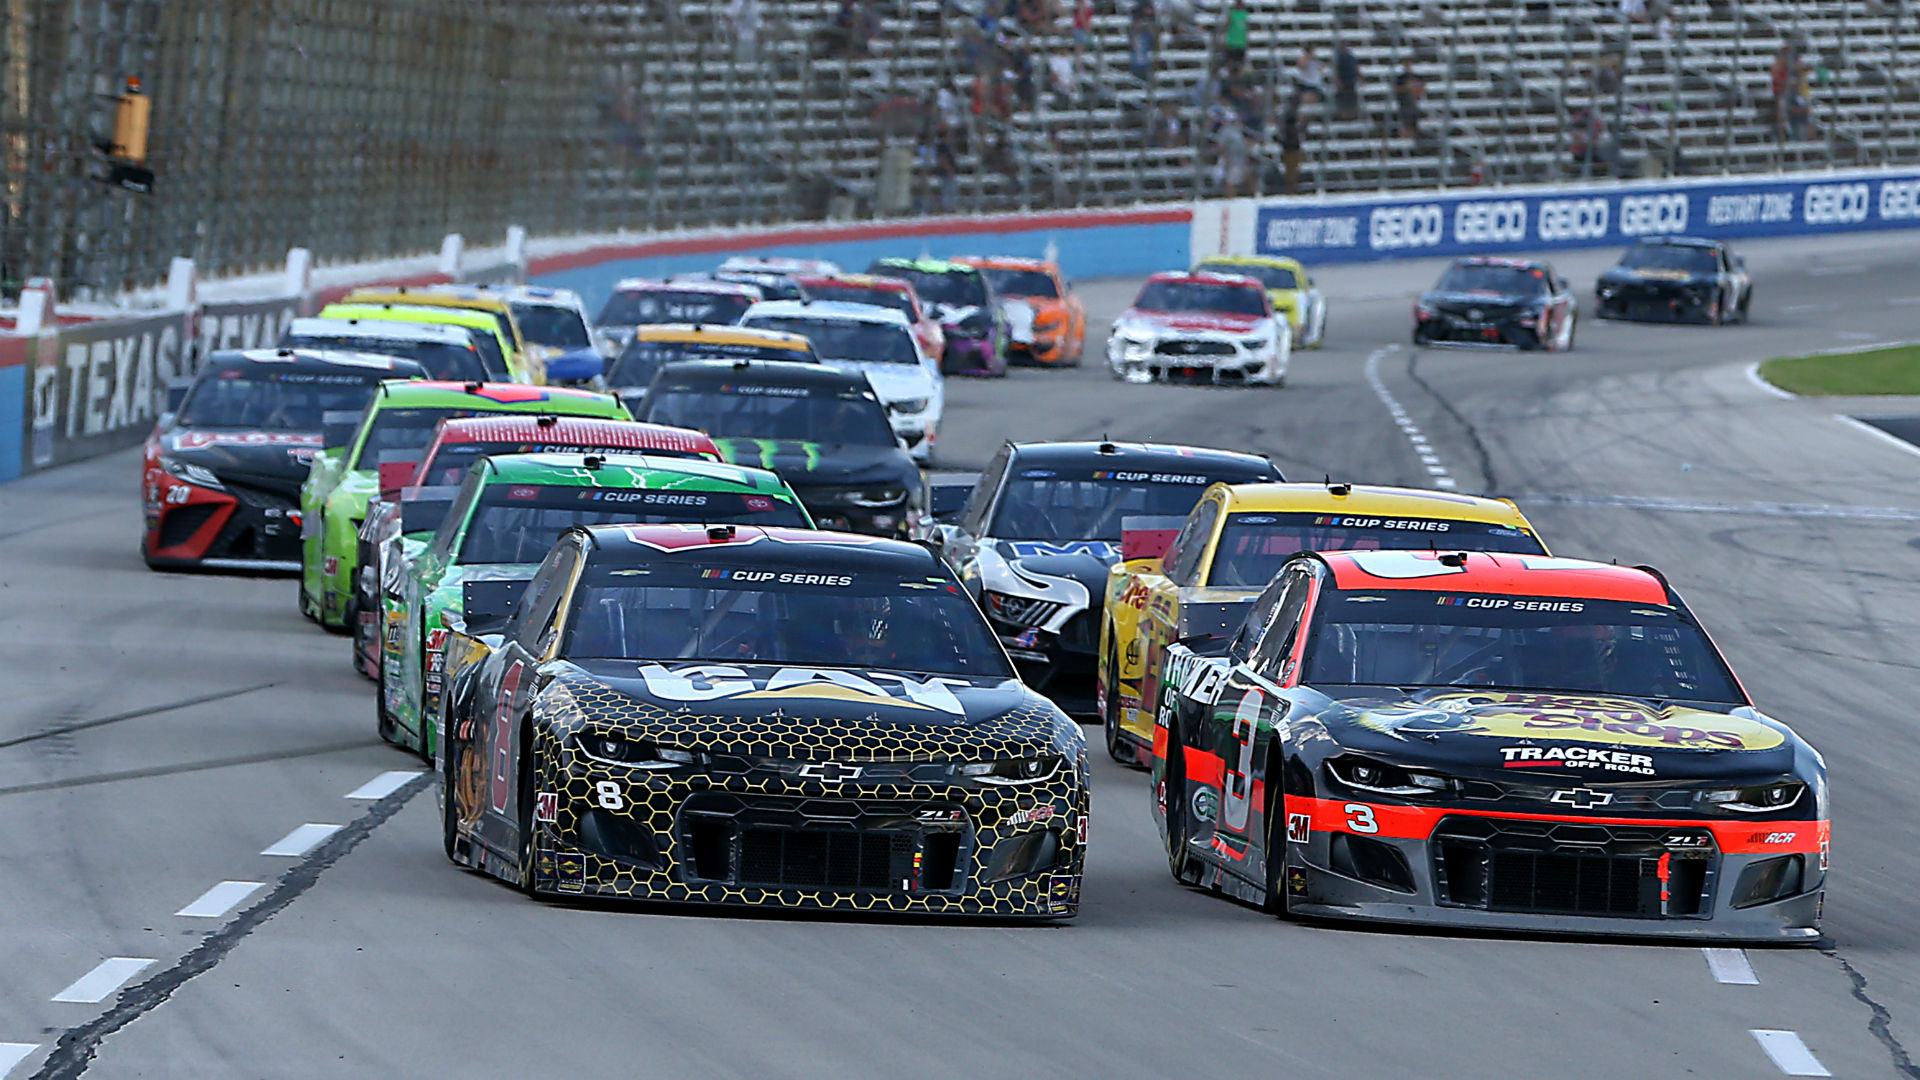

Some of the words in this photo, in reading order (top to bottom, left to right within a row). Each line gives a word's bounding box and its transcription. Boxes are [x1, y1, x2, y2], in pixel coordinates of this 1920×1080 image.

[1620, 193, 1688, 235] GEICO
[1707, 193, 1760, 226] RESTART
[1761, 192, 1793, 222] ZONE
[1804, 183, 1869, 224] GEICO
[1370, 204, 1443, 249] GEICO
[1455, 201, 1527, 243] GEICO
[1538, 198, 1609, 241] GEICO
[65, 326, 180, 439] TEXAS
[765, 387, 809, 396] SERIES
[1115, 472, 1149, 481] CUP
[1151, 473, 1207, 485] SERIES
[166, 485, 191, 504] 20
[604, 492, 642, 502] CUP
[644, 494, 708, 505] SERIES
[1342, 518, 1383, 528] CUP
[1384, 520, 1451, 532] SERIES
[731, 571, 776, 584] CUP
[778, 573, 853, 587] SERIES
[1466, 598, 1510, 610] CUP
[1512, 600, 1585, 613] SERIES
[426, 628, 449, 651] 3M
[638, 662, 972, 716] CAT
[493, 658, 524, 815] 8
[1225, 688, 1265, 833] 3
[1500, 747, 1653, 768] TRACKER
[1565, 760, 1601, 770] OFF
[1604, 763, 1656, 776] ROAD
[537, 794, 557, 821] 3M
[595, 780, 624, 810] 8
[916, 810, 961, 821] ZL1
[1288, 814, 1310, 843] 3M
[1344, 804, 1379, 834] 3
[1664, 836, 1708, 847] ZL1
[1763, 832, 1796, 844] RCR
